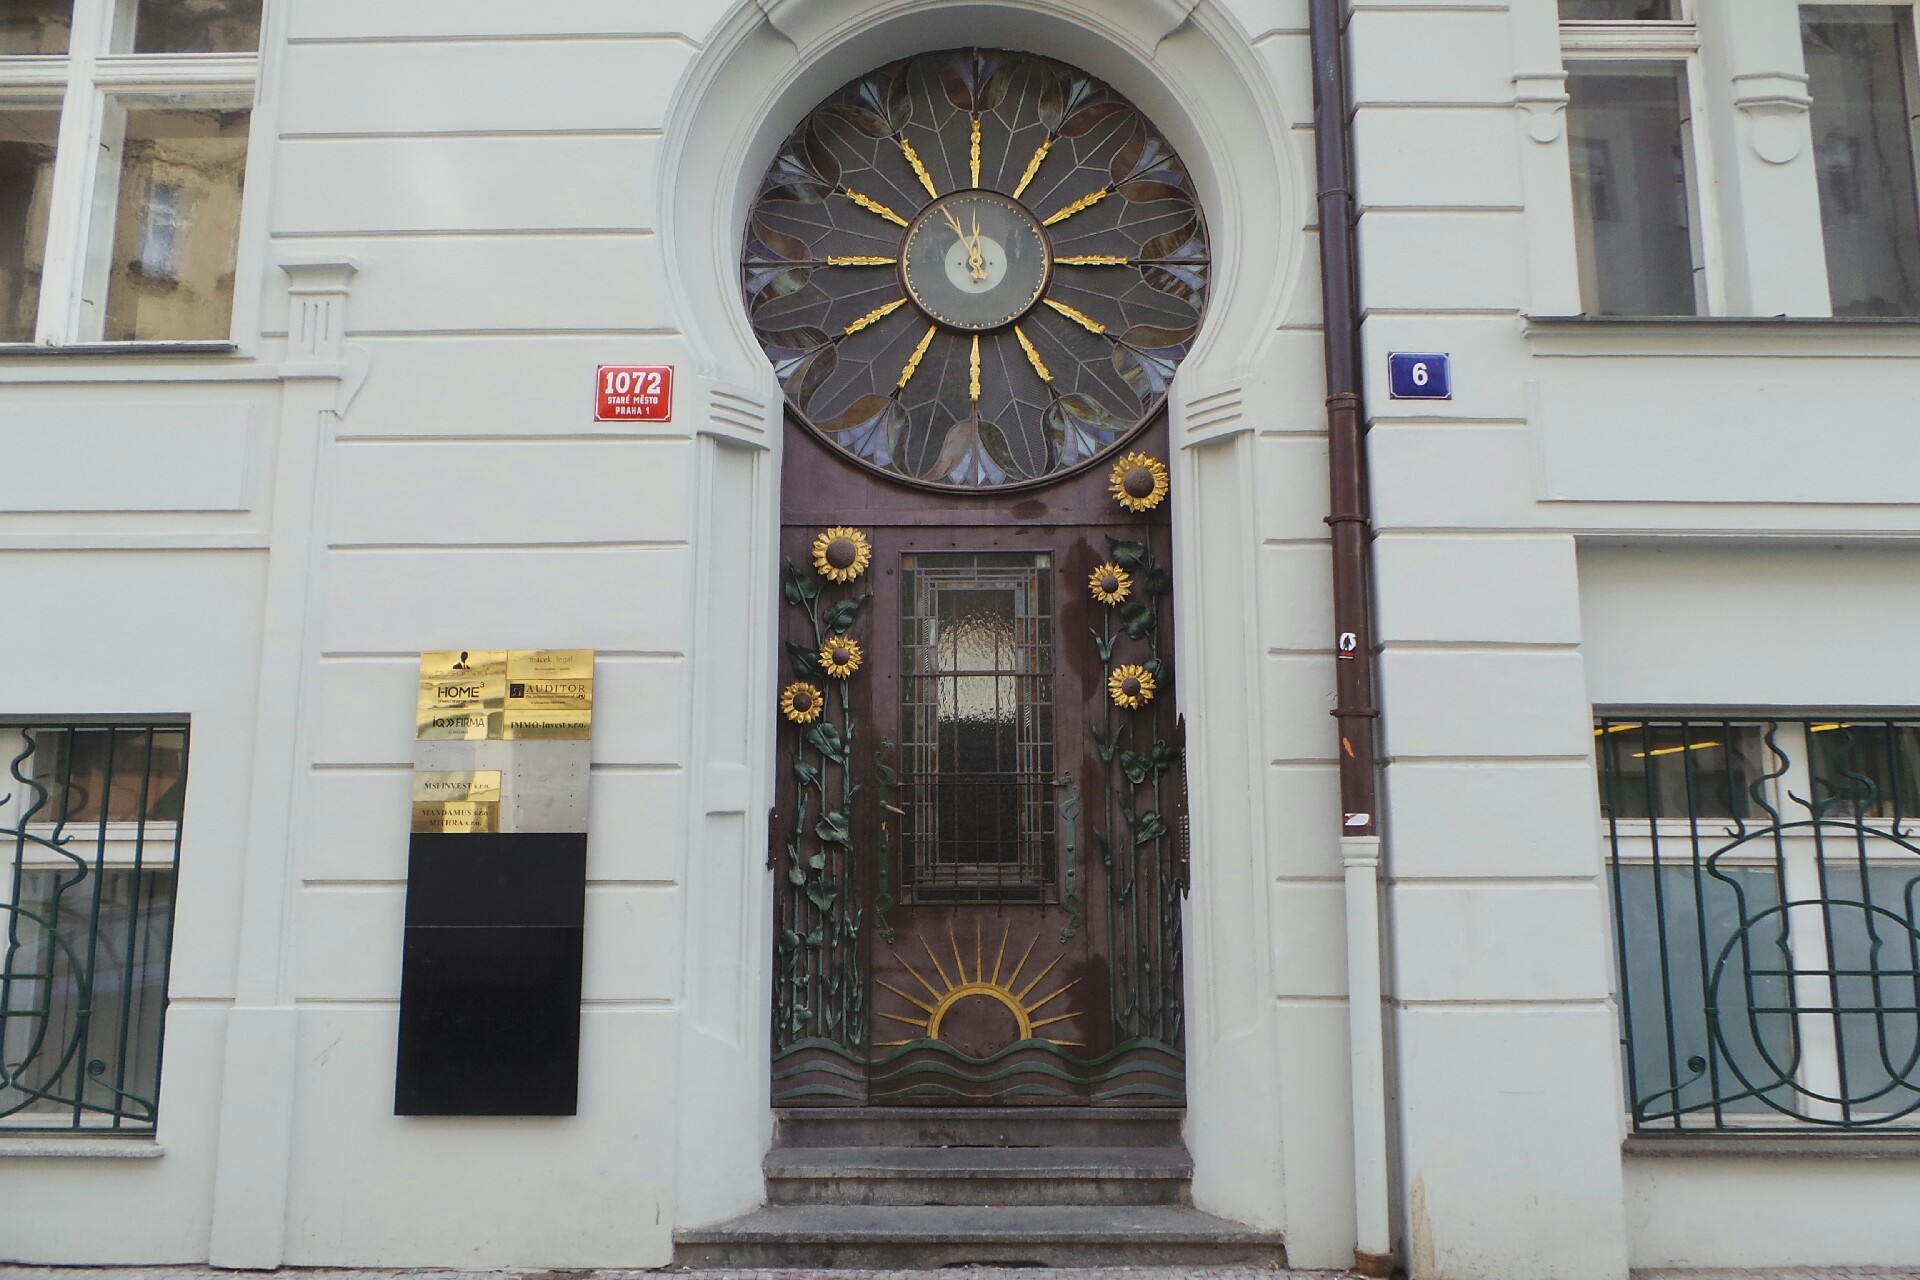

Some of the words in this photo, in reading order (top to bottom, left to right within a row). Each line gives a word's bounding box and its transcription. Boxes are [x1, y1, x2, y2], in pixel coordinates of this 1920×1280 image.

[1412, 362, 1429, 386] 6
[604, 371, 662, 395] 1072
[607, 394, 631, 405] STARÉ
[632, 394, 659, 405] MĚSTO
[615, 406, 643, 415] PRAHA
[645, 406, 650, 415] 1
[526, 684, 586, 693] AUDITOR
[455, 717, 485, 728] FIRMA
[510, 721, 566, 729] IMMO-Invest
[441, 782, 472, 790] INVEST
